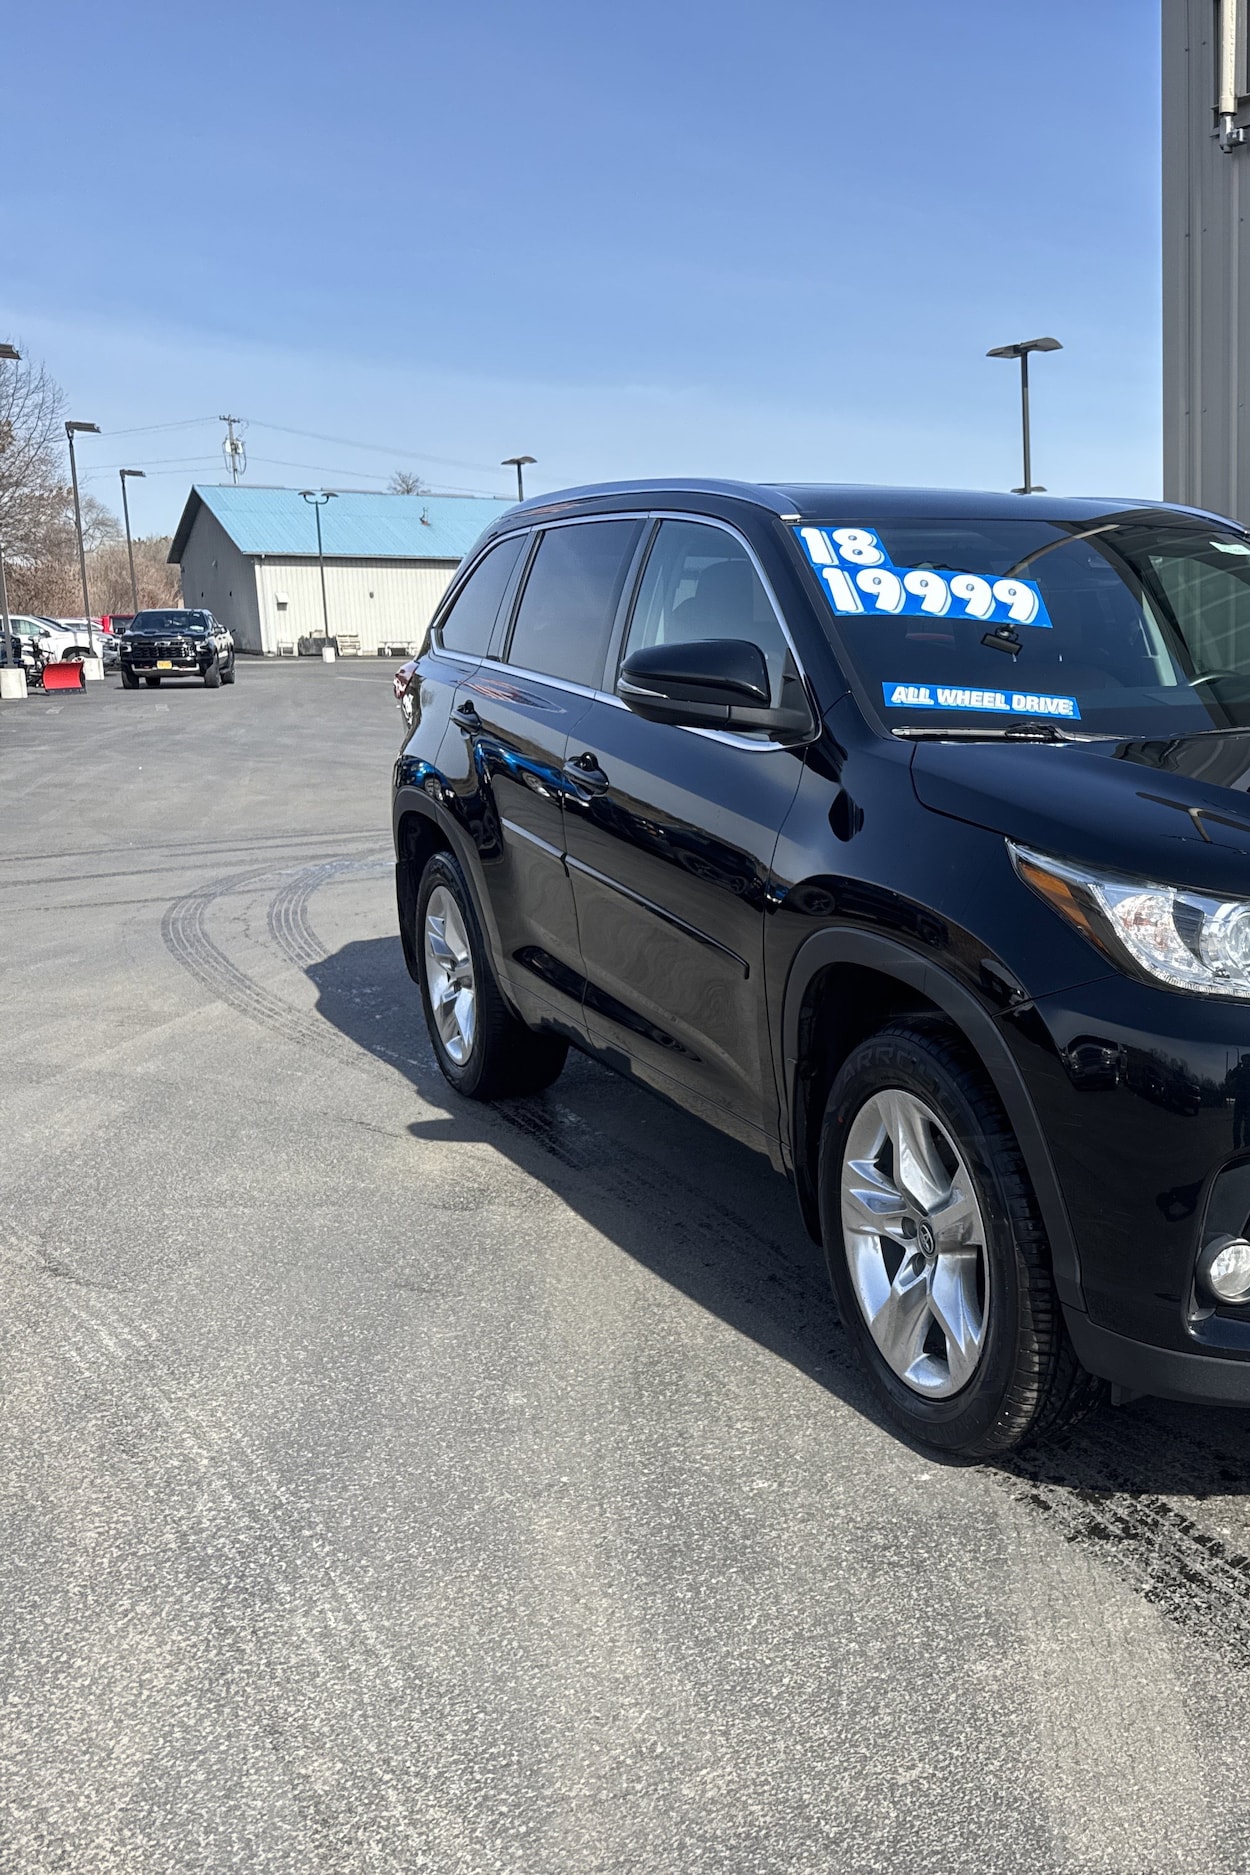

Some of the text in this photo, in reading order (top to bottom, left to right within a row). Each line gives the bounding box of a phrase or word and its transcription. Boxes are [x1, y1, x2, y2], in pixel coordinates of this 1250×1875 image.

[801, 527, 885, 566] 18
[822, 567, 1039, 624] 19999
[891, 685, 1074, 716] ALL WHEEL DRIVE
